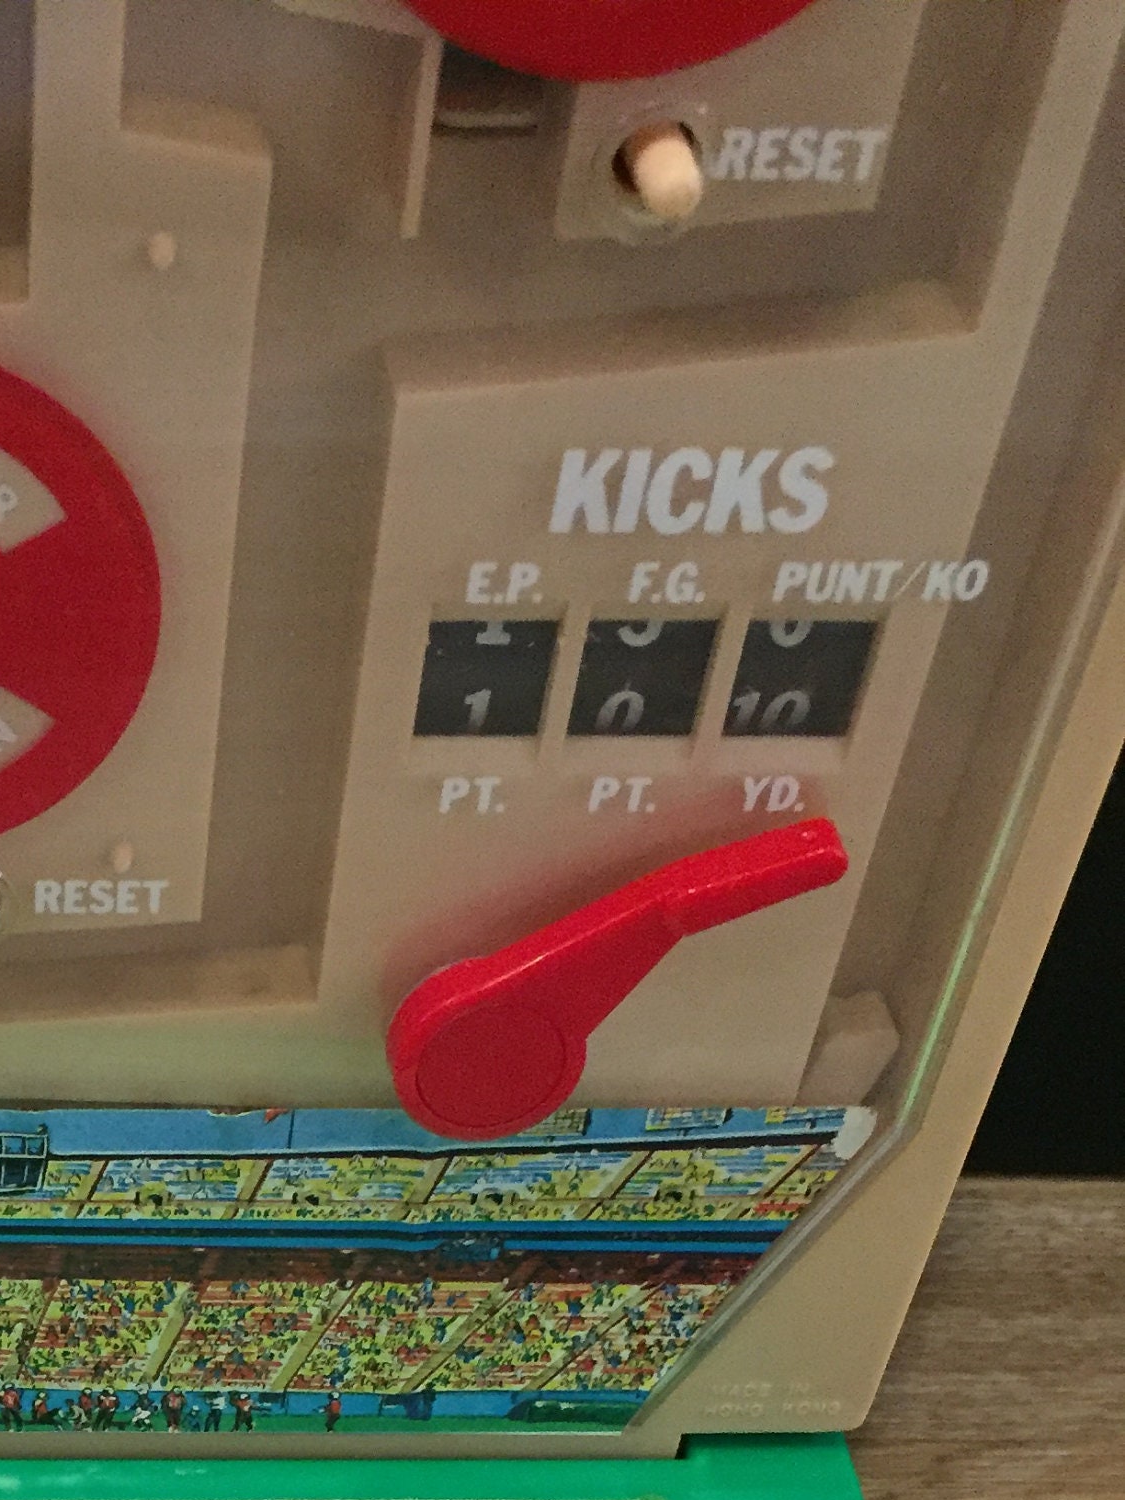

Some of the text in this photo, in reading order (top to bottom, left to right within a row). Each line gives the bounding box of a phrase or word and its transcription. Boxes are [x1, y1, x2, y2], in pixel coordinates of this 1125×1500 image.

[711, 126, 888, 181] RESET
[548, 446, 837, 535] KICKS
[465, 562, 542, 604] E.P.
[628, 562, 706, 604] F.G.
[438, 776, 805, 813] PT. PT. YD.
[34, 878, 168, 915] RESET
